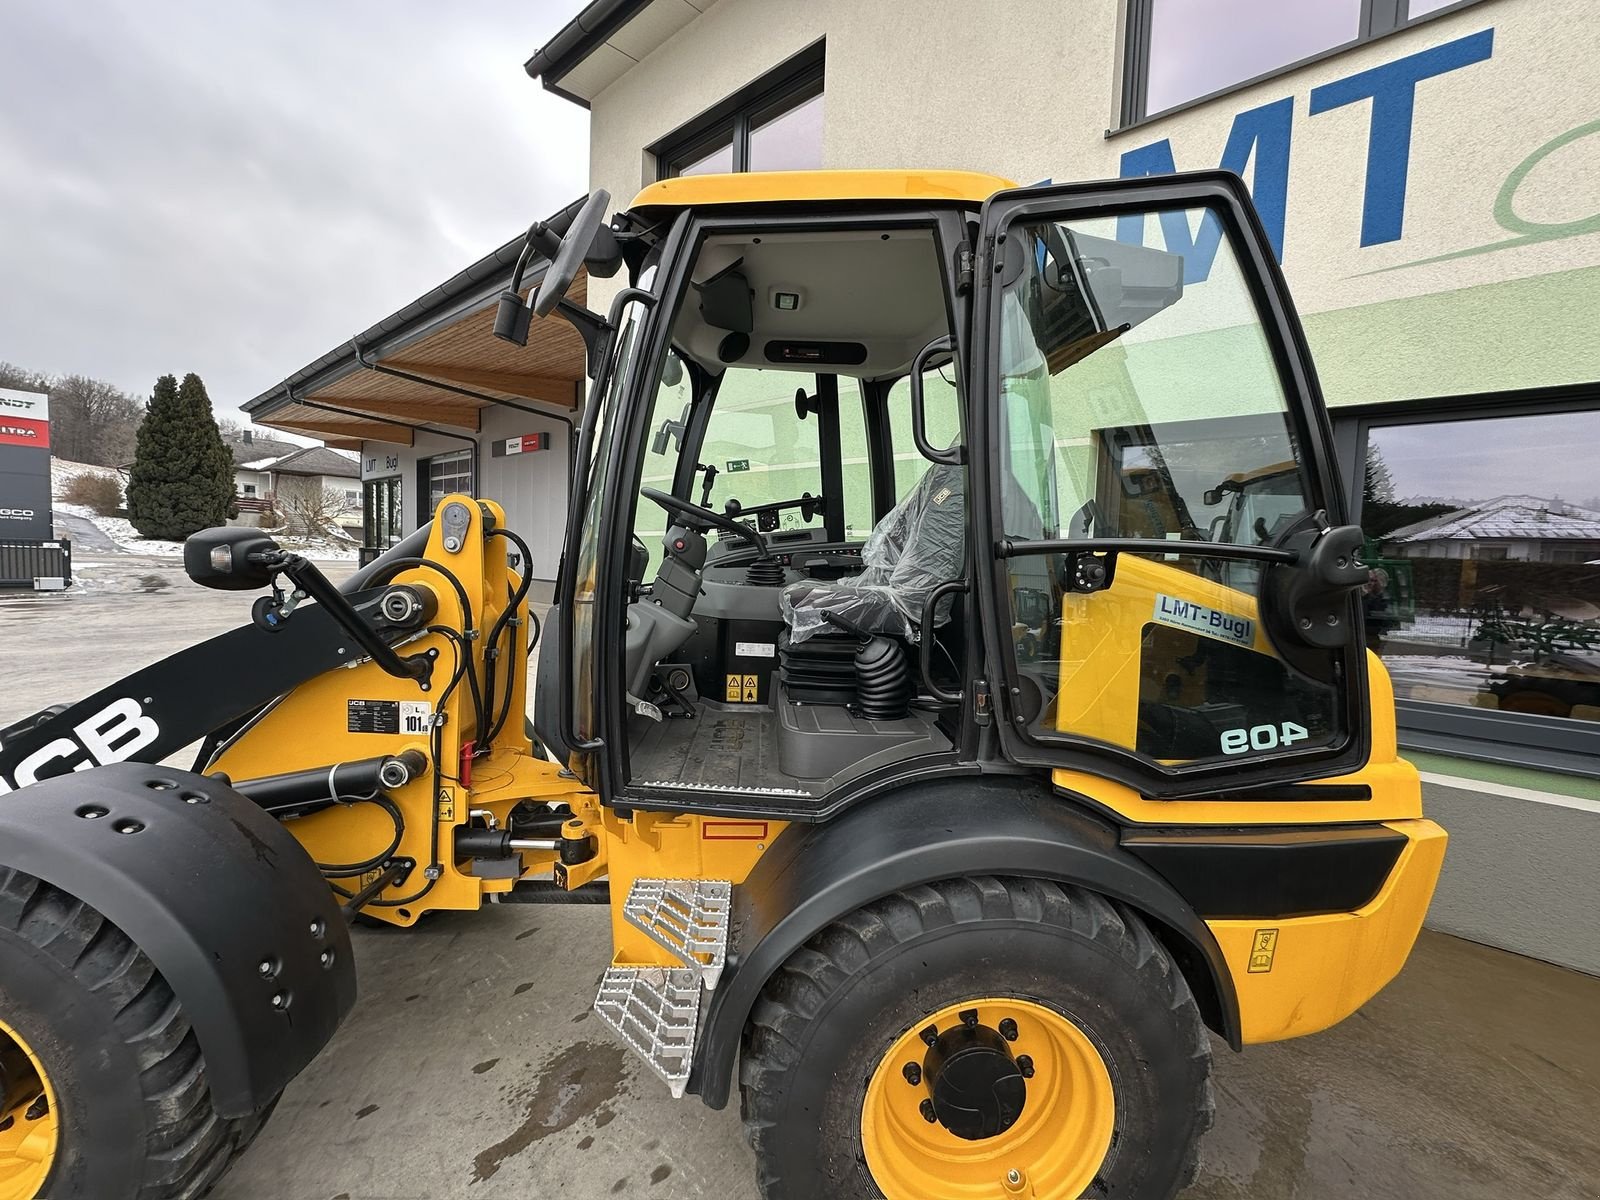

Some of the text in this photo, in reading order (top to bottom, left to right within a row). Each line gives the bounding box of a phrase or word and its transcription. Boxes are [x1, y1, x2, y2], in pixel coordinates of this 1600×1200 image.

[1030, 27, 1495, 286] MT
[1161, 596, 1251, 639] LMT-Bugl
[0, 697, 160, 796] CB
[405, 715, 422, 732] 101
